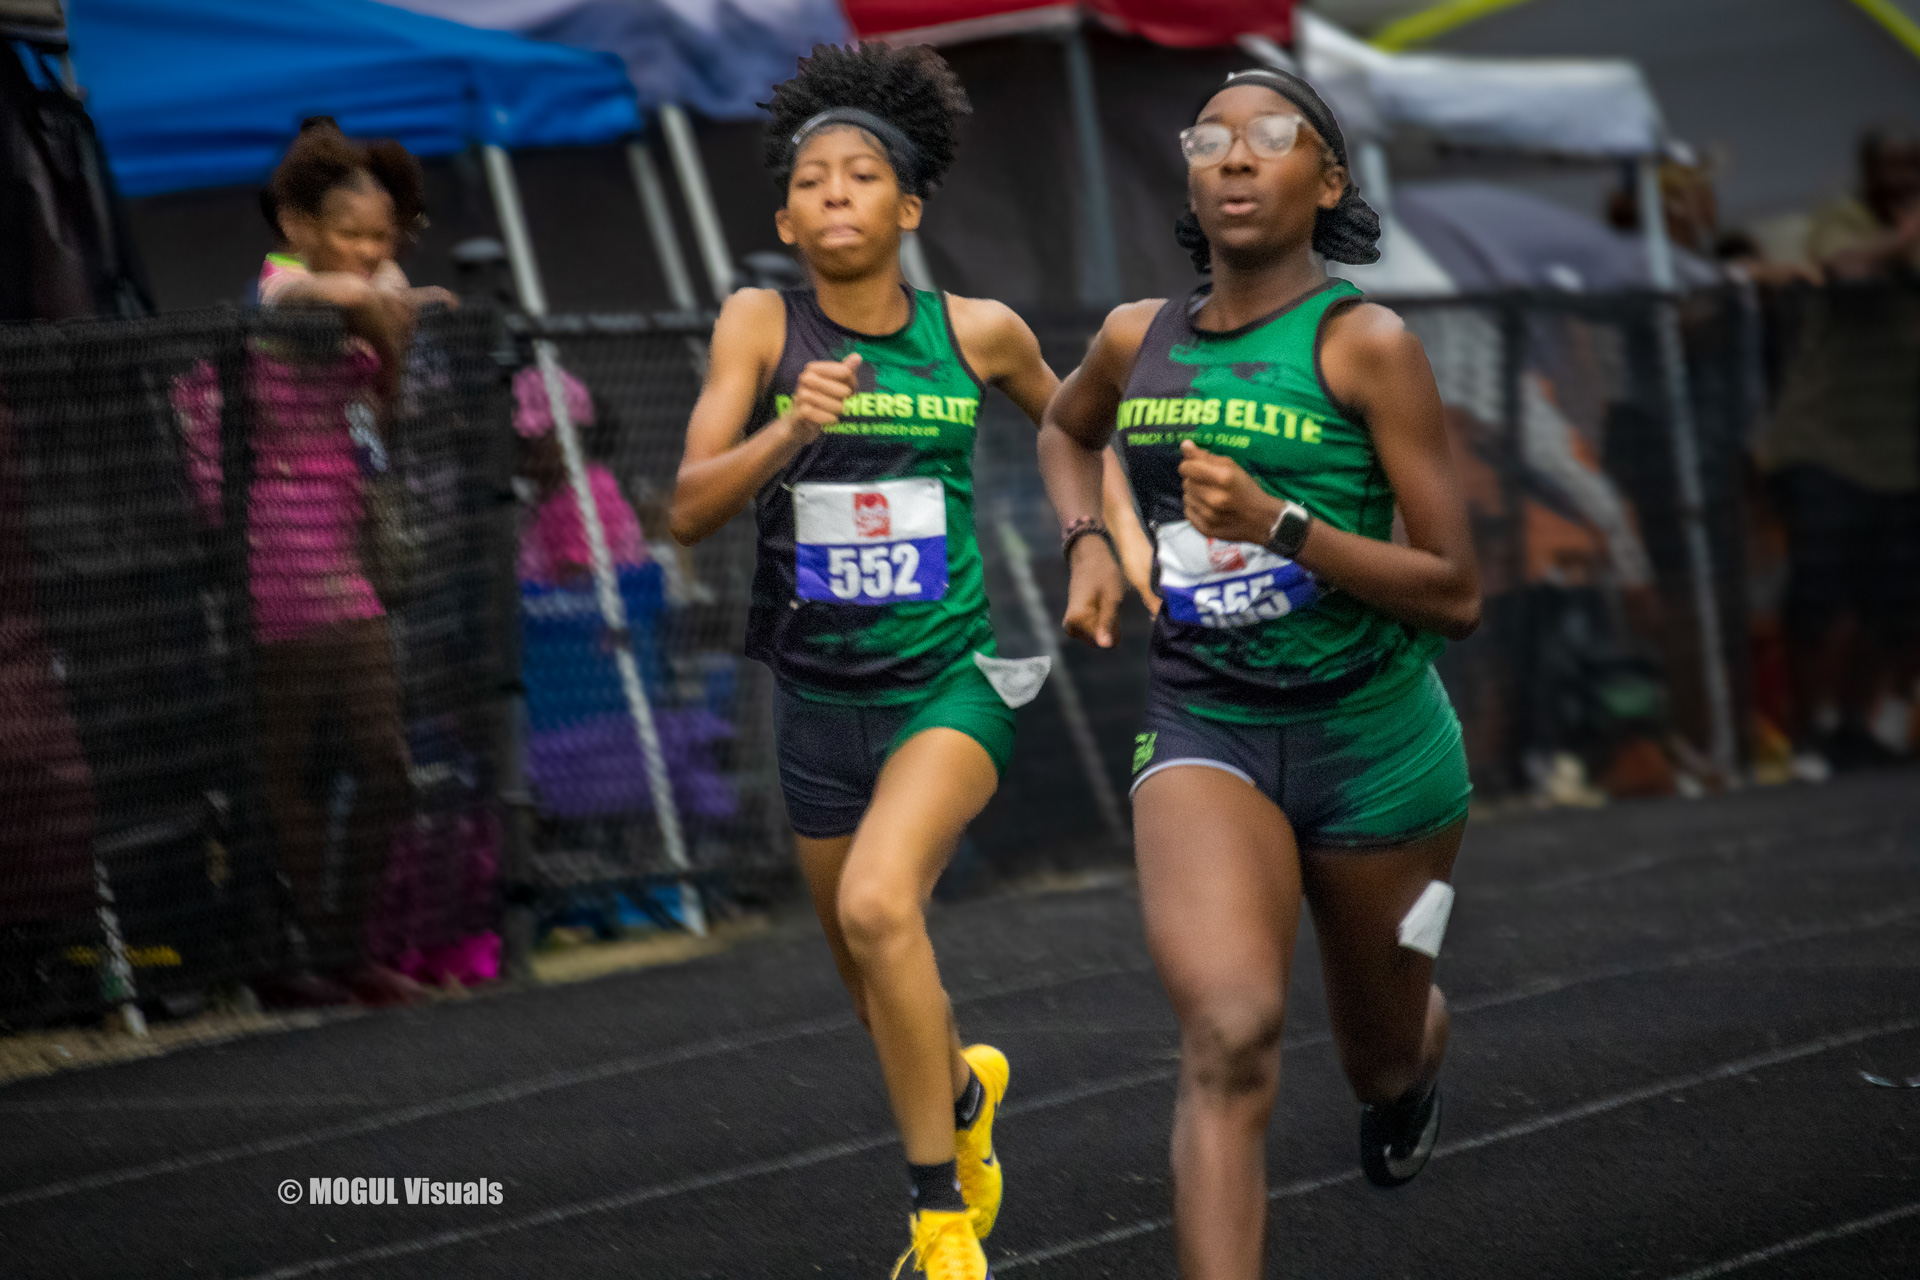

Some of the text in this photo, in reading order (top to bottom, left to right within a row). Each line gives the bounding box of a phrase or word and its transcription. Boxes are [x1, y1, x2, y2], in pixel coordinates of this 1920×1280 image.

[776, 392, 914, 419] PHERS
[1116, 398, 1325, 443] NTHERS ELITE
[828, 543, 922, 599] 552
